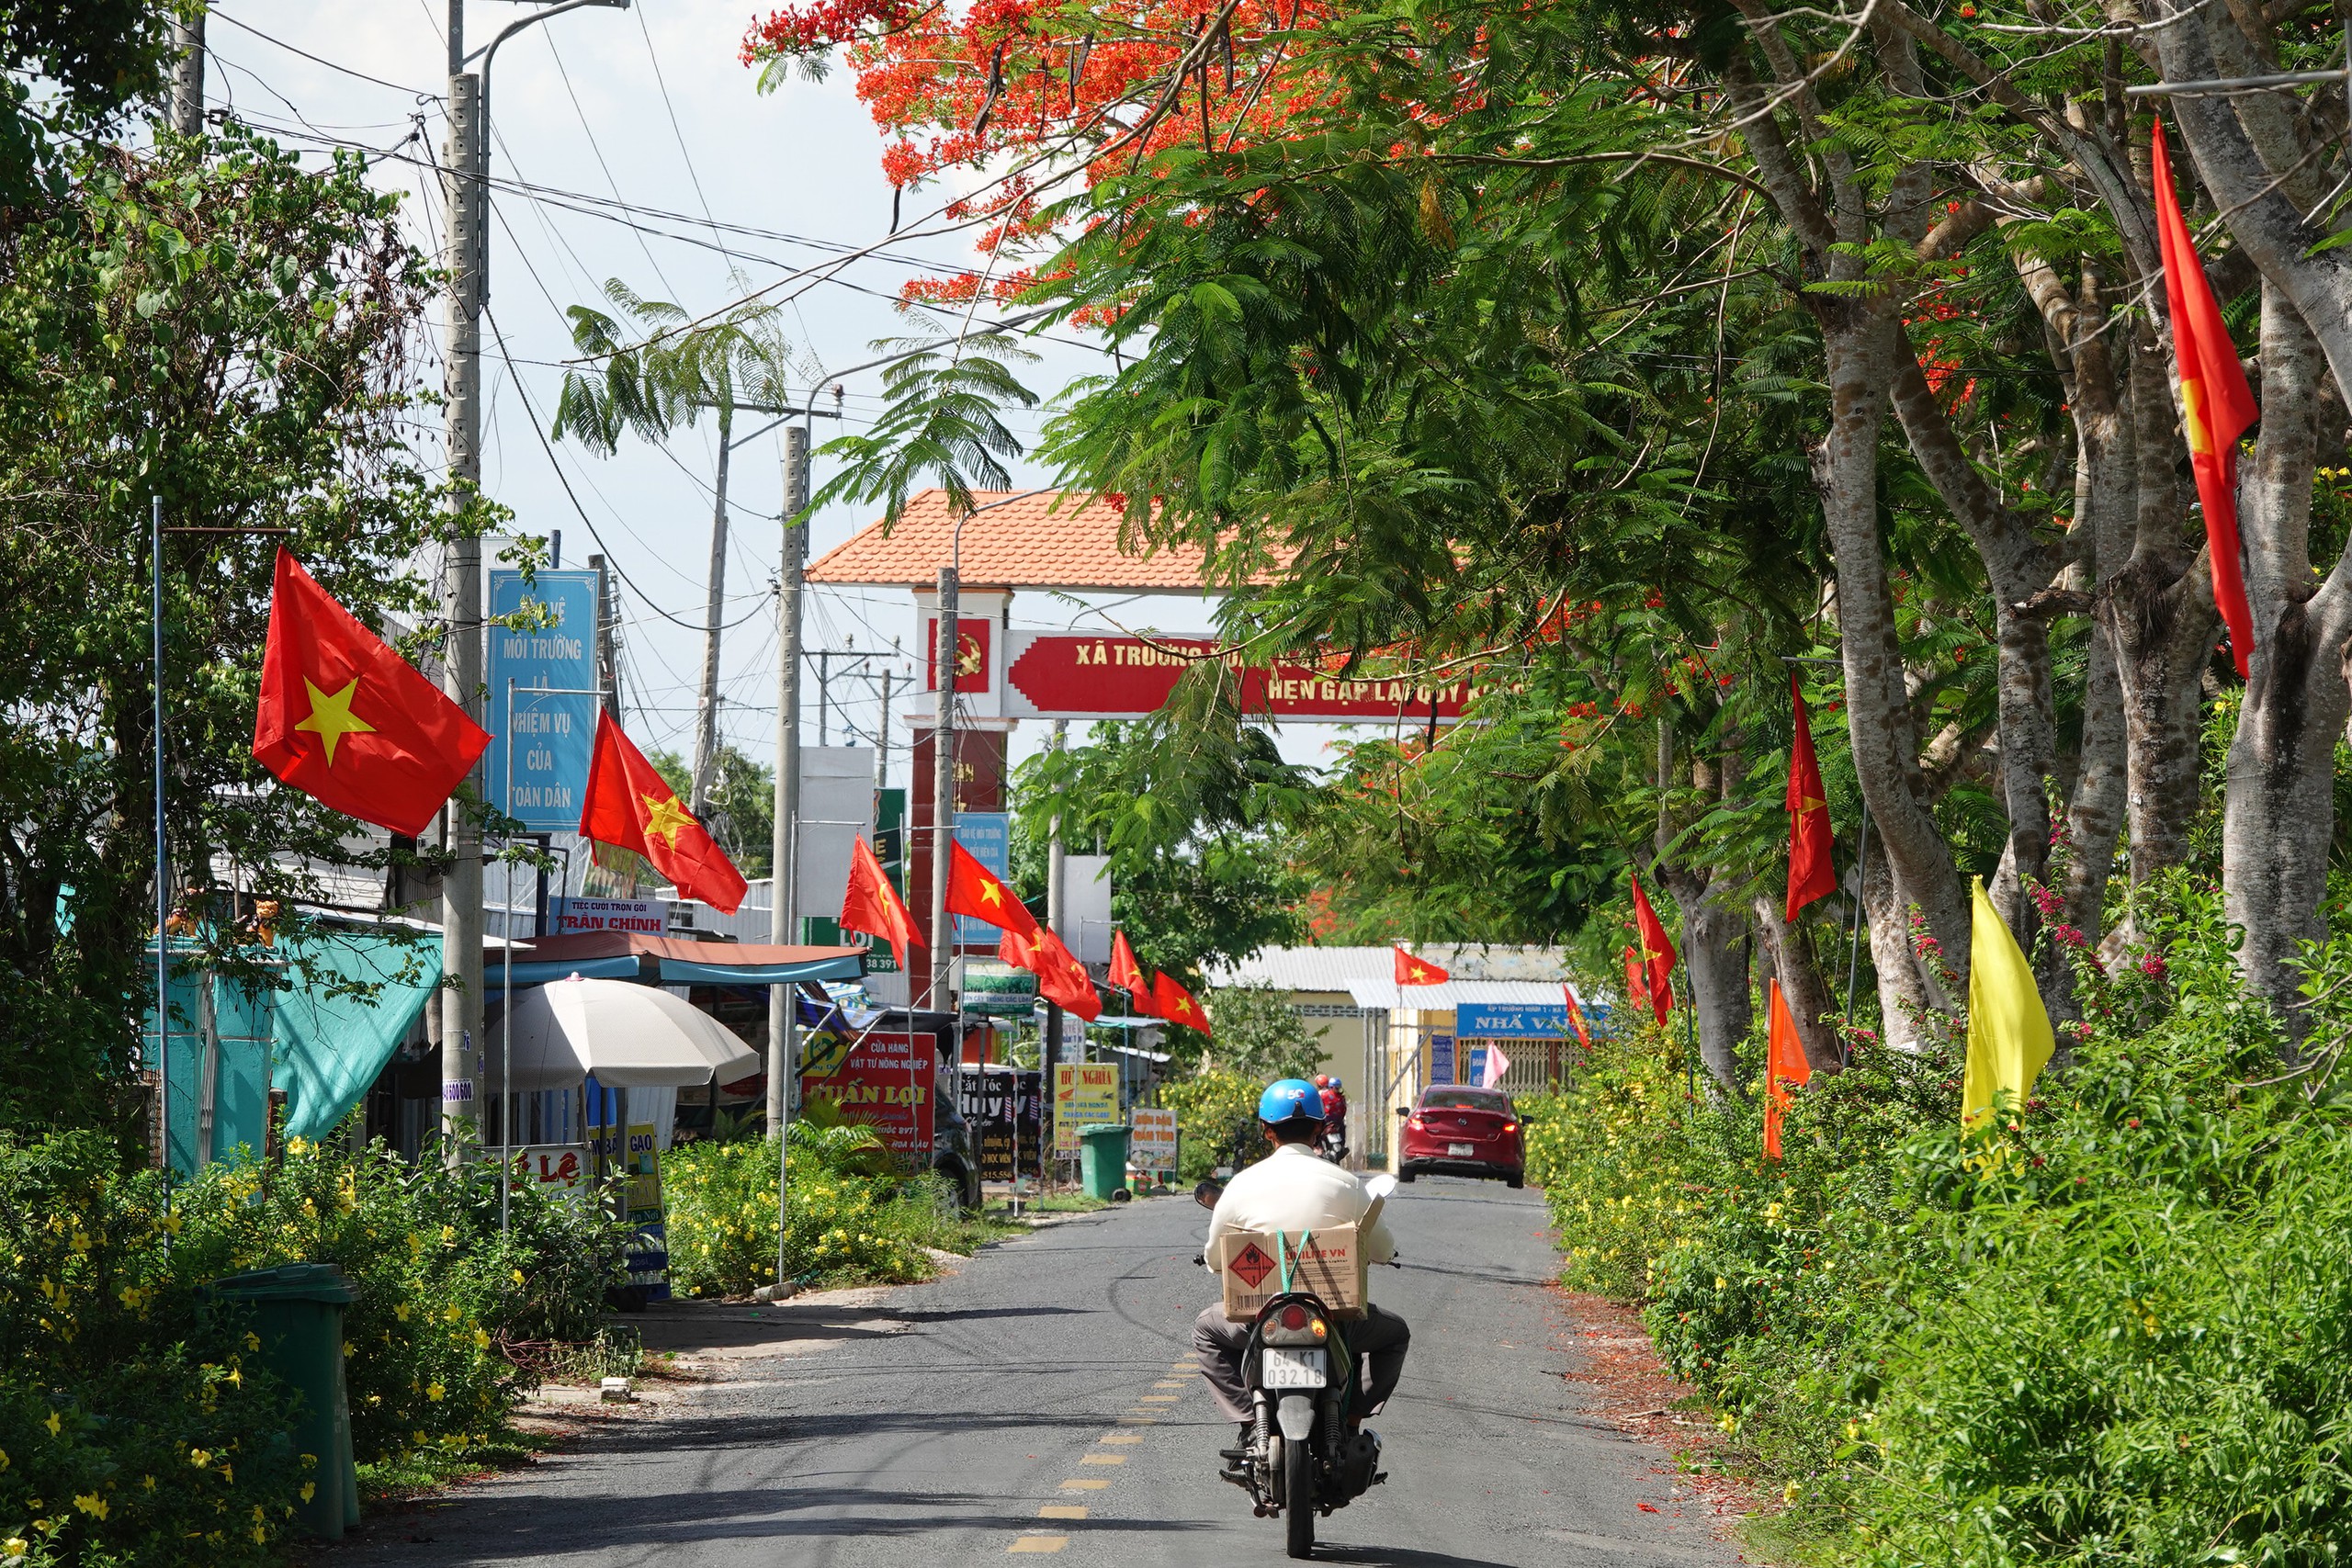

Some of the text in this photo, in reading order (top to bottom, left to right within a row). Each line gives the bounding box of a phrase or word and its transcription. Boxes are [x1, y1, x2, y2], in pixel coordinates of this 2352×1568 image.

[503, 634, 582, 660] MÔI TRƯỜNG
[1076, 640, 1108, 665] XÃ
[533, 671, 548, 695] LÀ
[1269, 680, 1316, 705] HẸN
[554, 713, 571, 738] VỤ
[527, 743, 552, 771] CỦA
[512, 782, 571, 808] OÀN DÂN
[557, 912, 662, 931] TRẦN CHÍNH
[1475, 1014, 1524, 1029] NHÀ
[871, 1040, 909, 1054] CỬA HÀNG
[851, 1056, 865, 1070] VẬT
[867, 1057, 878, 1069] TƯ
[878, 1057, 899, 1069] NÔNG
[630, 1134, 652, 1155] GẠO
[1330, 1248, 1346, 1258] VN
[1268, 1369, 1322, 1385] 032.18
